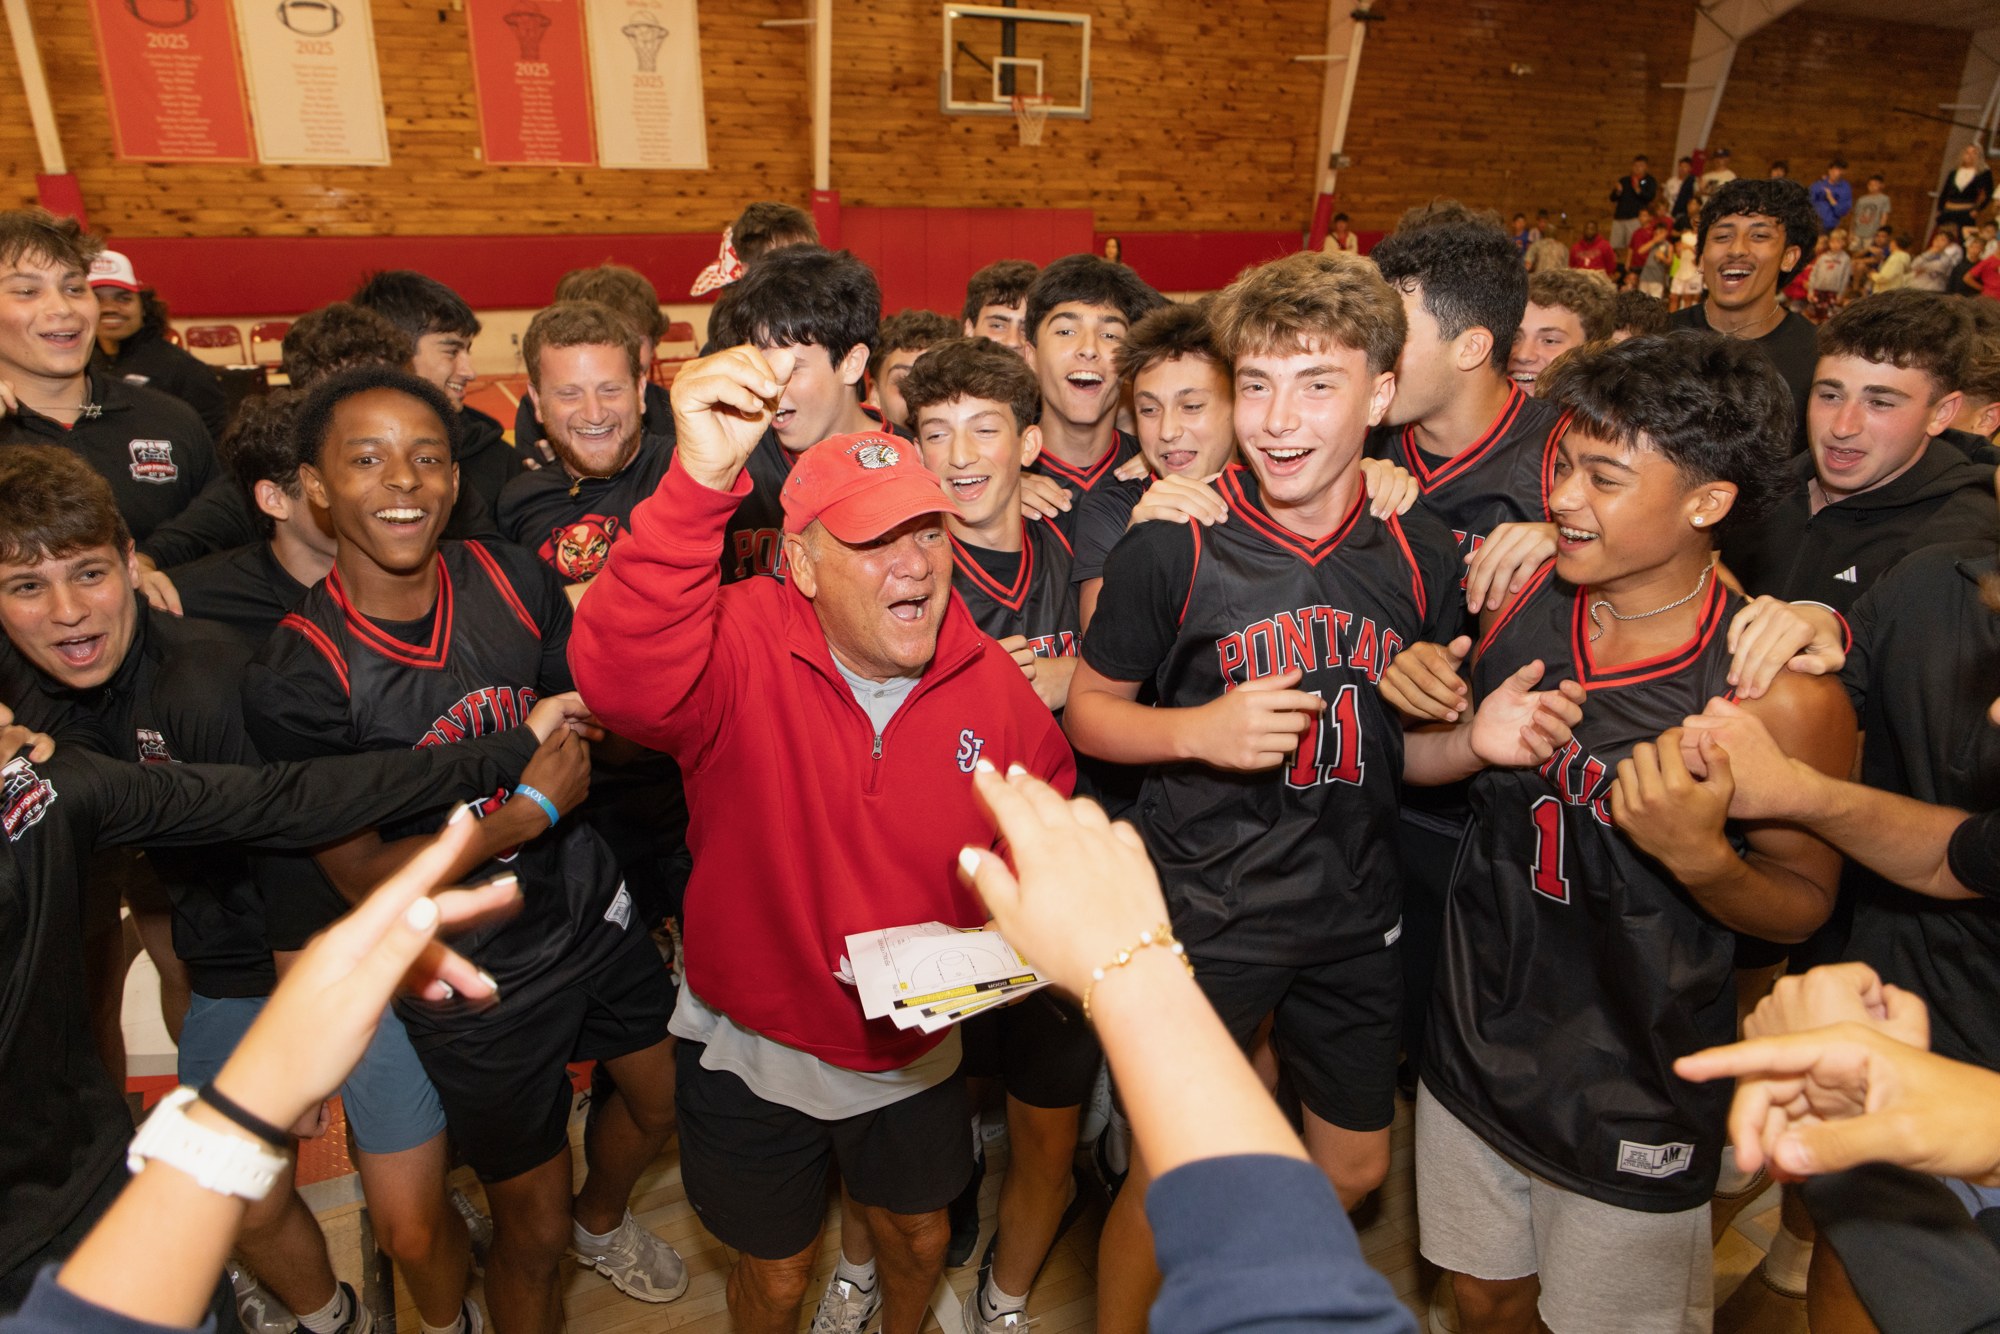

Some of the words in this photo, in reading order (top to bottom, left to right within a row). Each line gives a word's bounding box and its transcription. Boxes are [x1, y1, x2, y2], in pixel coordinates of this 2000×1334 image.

[146, 32, 189, 49] 2025
[294, 40, 334, 55] 2025
[514, 62, 549, 77] 2025
[1285, 684, 1365, 790] 11
[4, 806, 22, 830] CAMP
[20, 785, 46, 809] PONTIAC
[1530, 795, 1570, 905] 1
